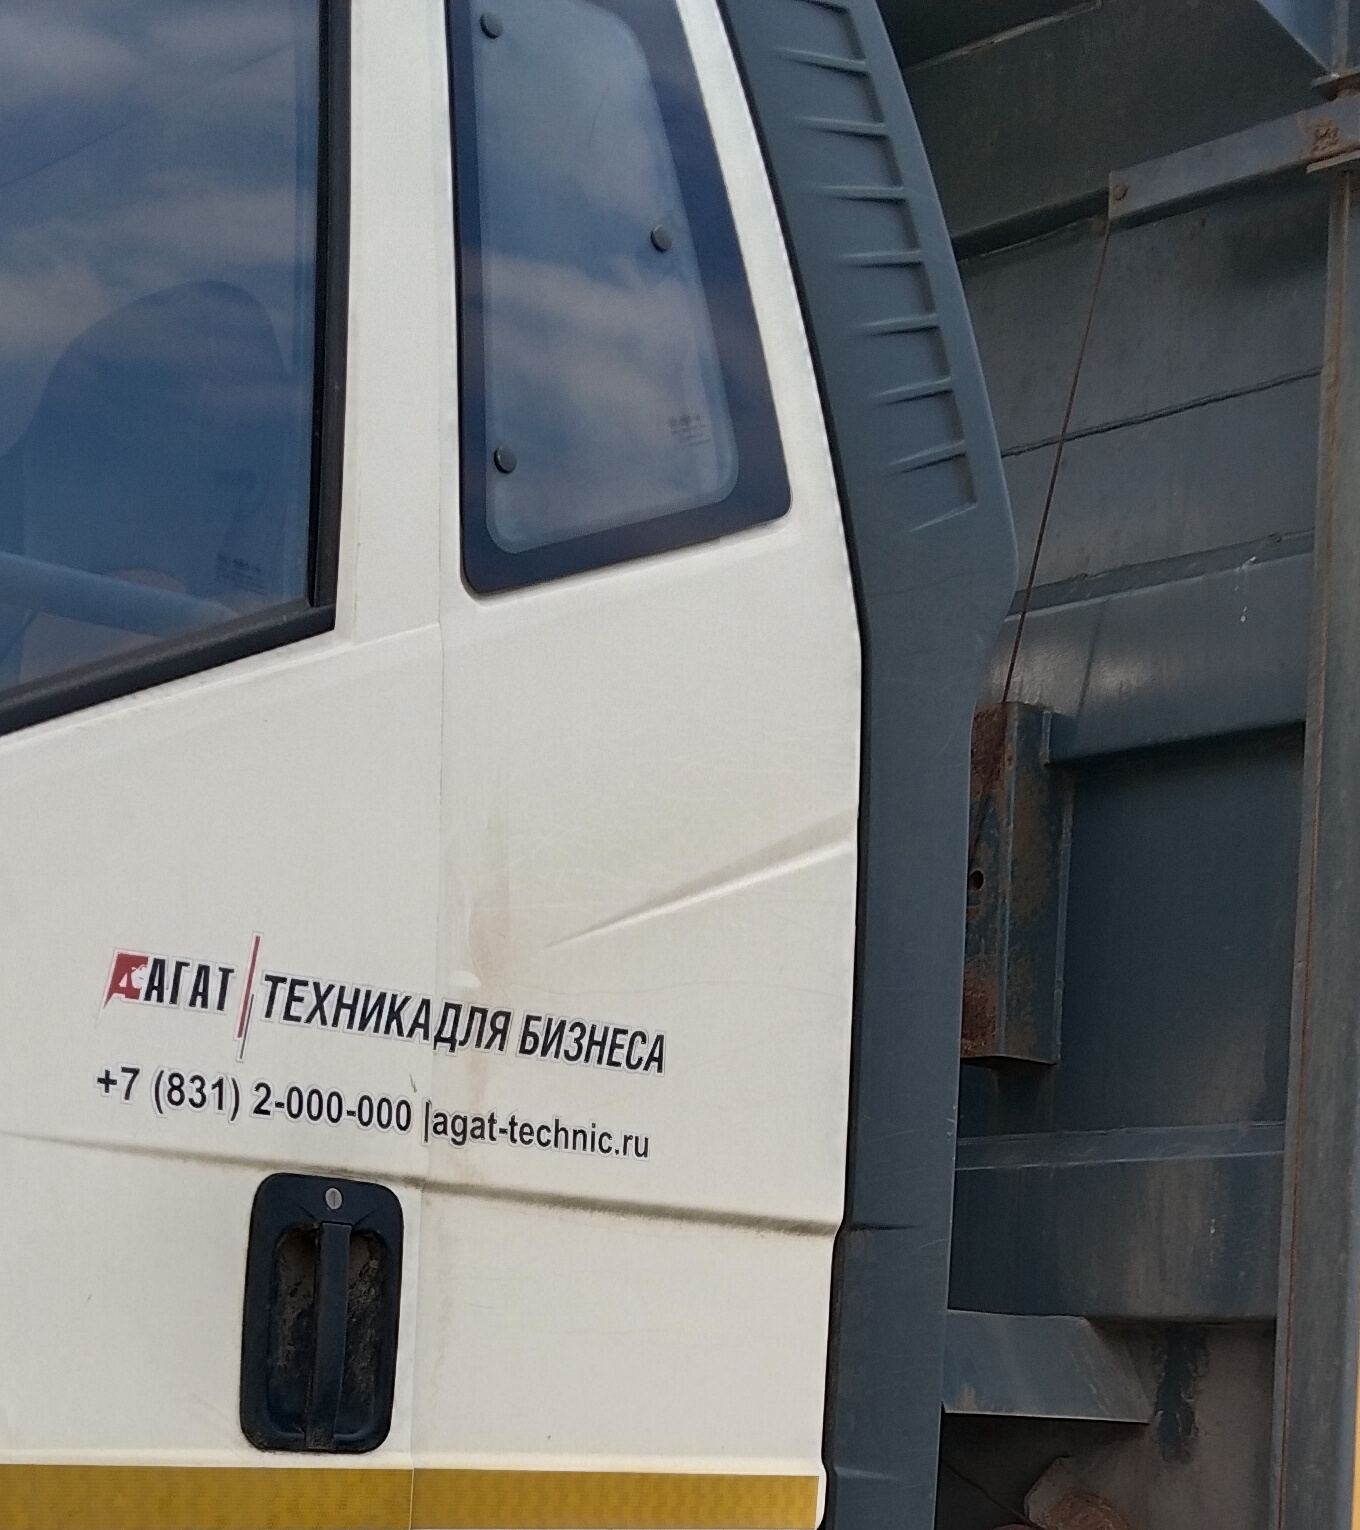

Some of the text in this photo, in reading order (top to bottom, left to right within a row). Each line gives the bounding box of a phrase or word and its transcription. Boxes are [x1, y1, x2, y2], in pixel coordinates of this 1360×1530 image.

[143, 956, 235, 1013] АГАТ
[518, 1015, 666, 1075] БИЗНЕСА
[96, 1066, 141, 1102] +7
[154, 1073, 242, 1121] (831)
[252, 1081, 413, 1132] 2-000-000
